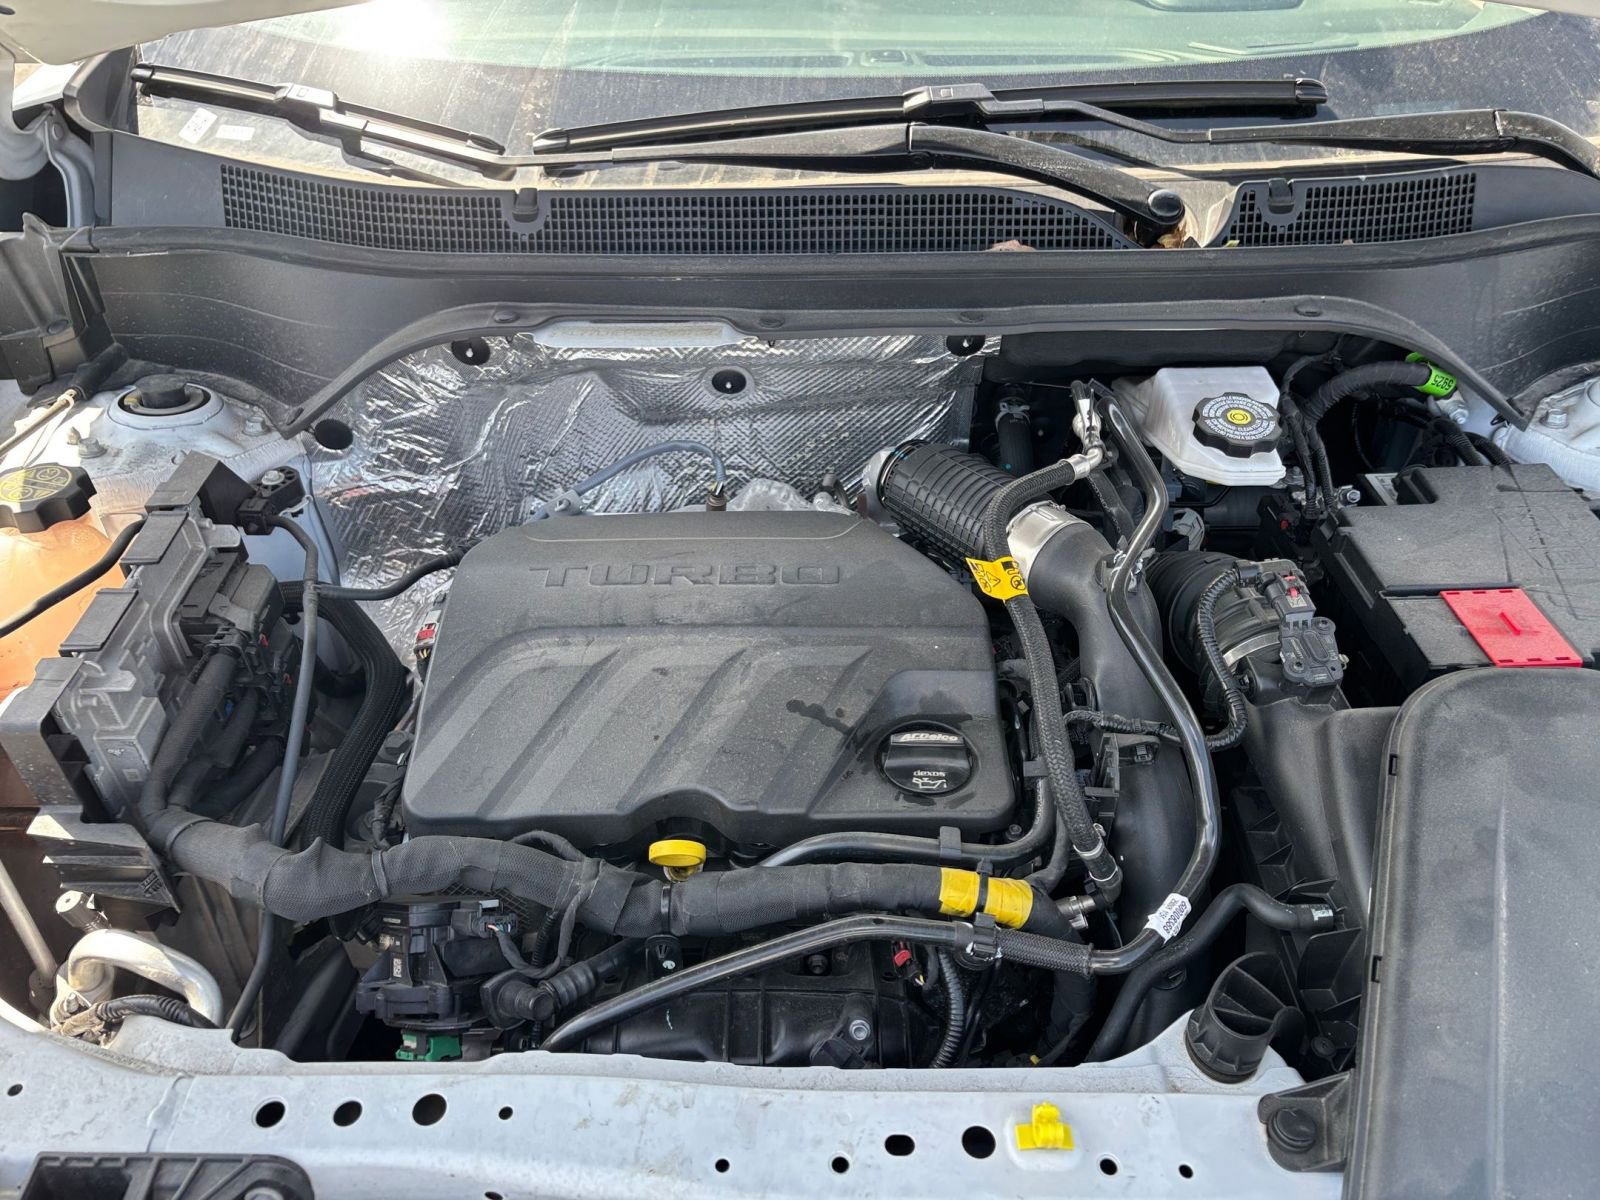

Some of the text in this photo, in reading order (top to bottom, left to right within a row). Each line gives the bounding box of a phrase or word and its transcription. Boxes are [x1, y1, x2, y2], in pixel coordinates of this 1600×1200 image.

[1431, 374, 1454, 391] 5925
[528, 564, 840, 588] TURBO
[913, 769, 946, 777] dexos
